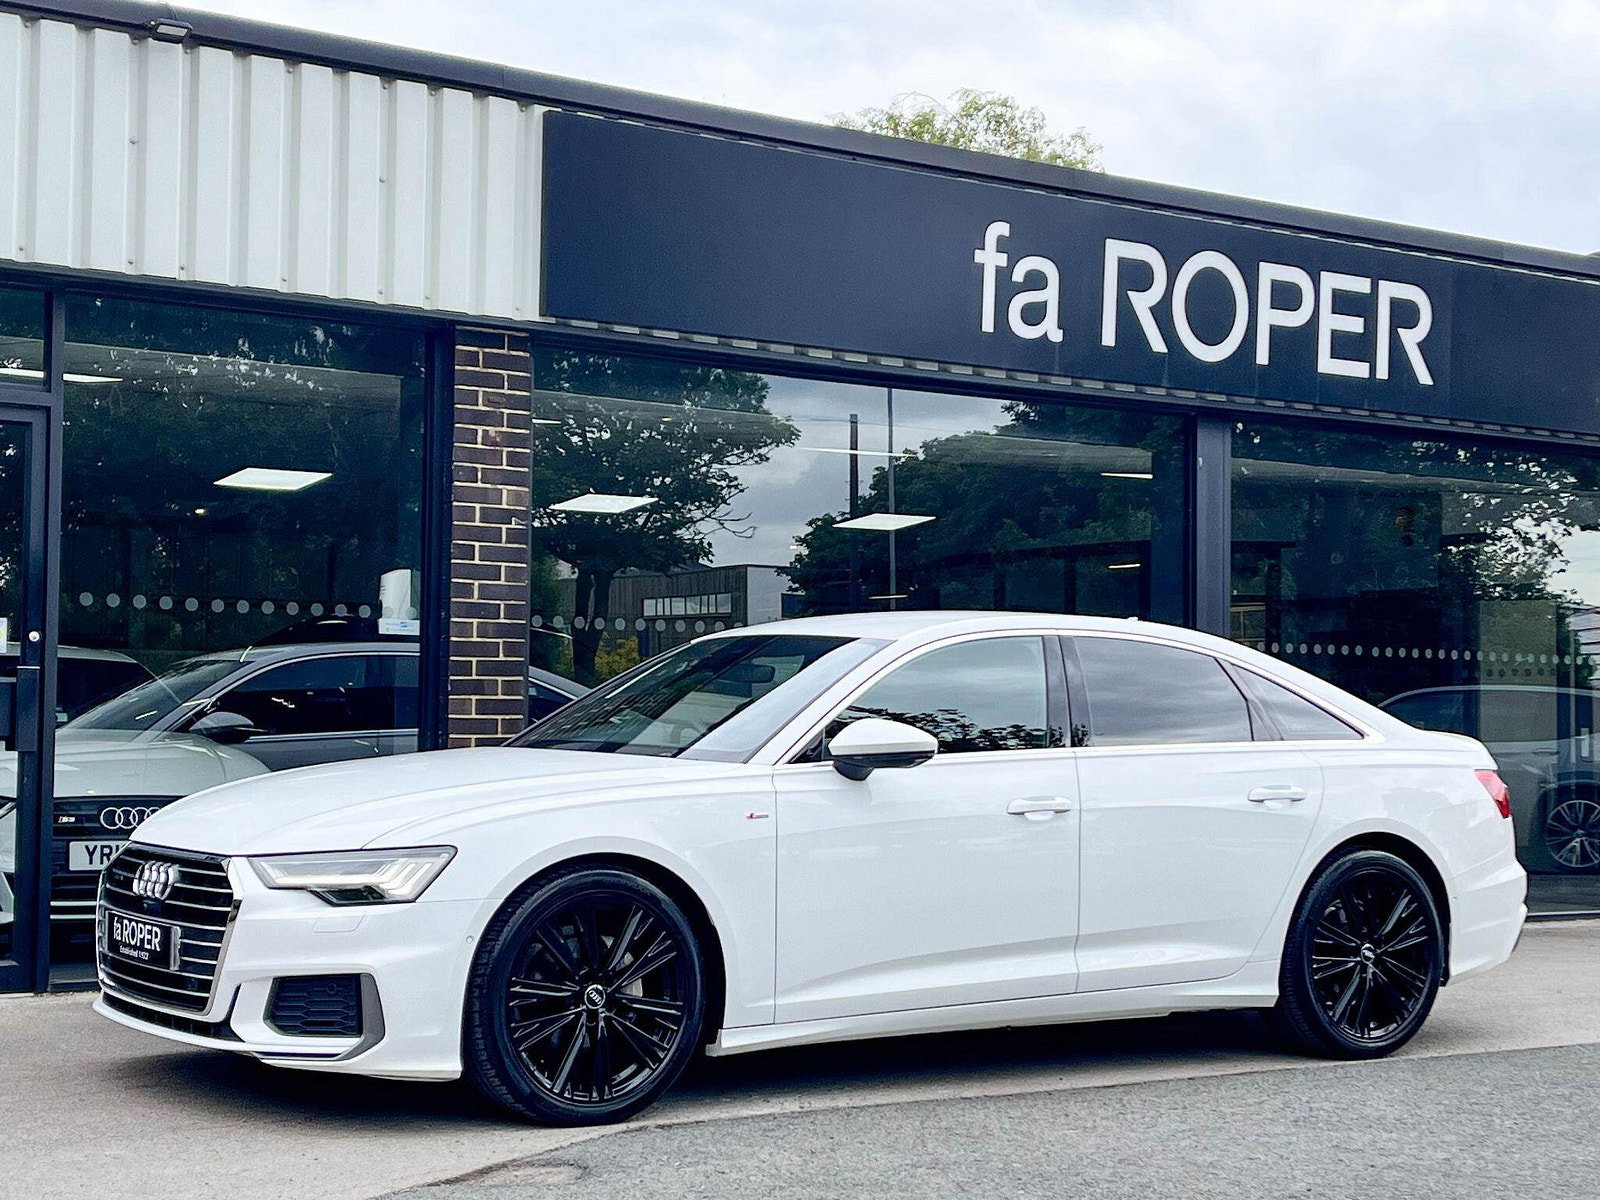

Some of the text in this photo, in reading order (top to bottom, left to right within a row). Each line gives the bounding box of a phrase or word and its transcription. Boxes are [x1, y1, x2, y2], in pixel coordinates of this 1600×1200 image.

[974, 221, 1434, 386] fa ROPER
[113, 916, 161, 952] fa ROPER
